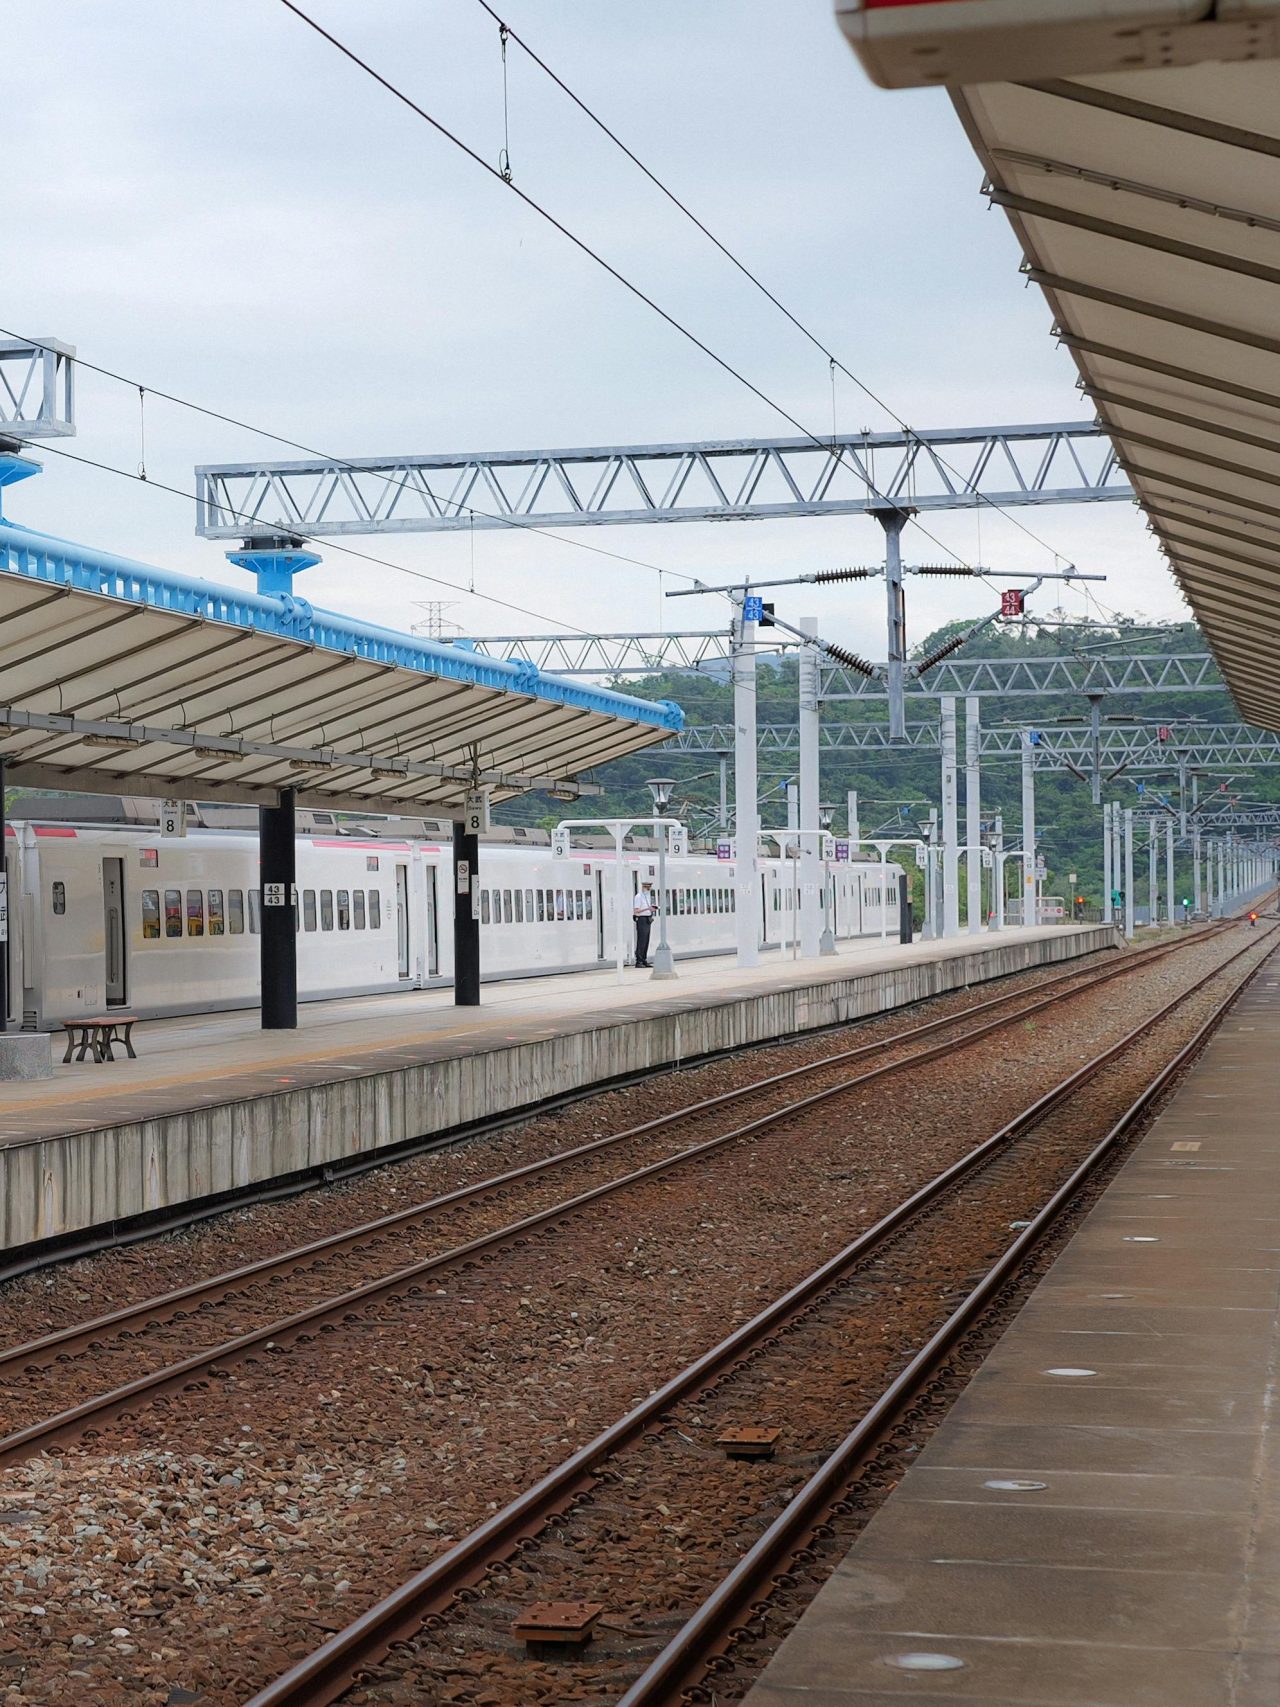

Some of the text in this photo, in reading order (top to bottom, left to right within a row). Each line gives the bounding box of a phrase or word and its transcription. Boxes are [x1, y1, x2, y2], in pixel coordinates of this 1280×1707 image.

[1004, 593, 1015, 602] 43
[748, 598, 759, 607] 43
[748, 609, 759, 618] 43
[166, 819, 174, 832] 8
[471, 815, 480, 828] 8
[556, 846, 563, 855] 9
[673, 844, 680, 853] 9
[267, 885, 280, 893] 43
[267, 896, 280, 904] 43
